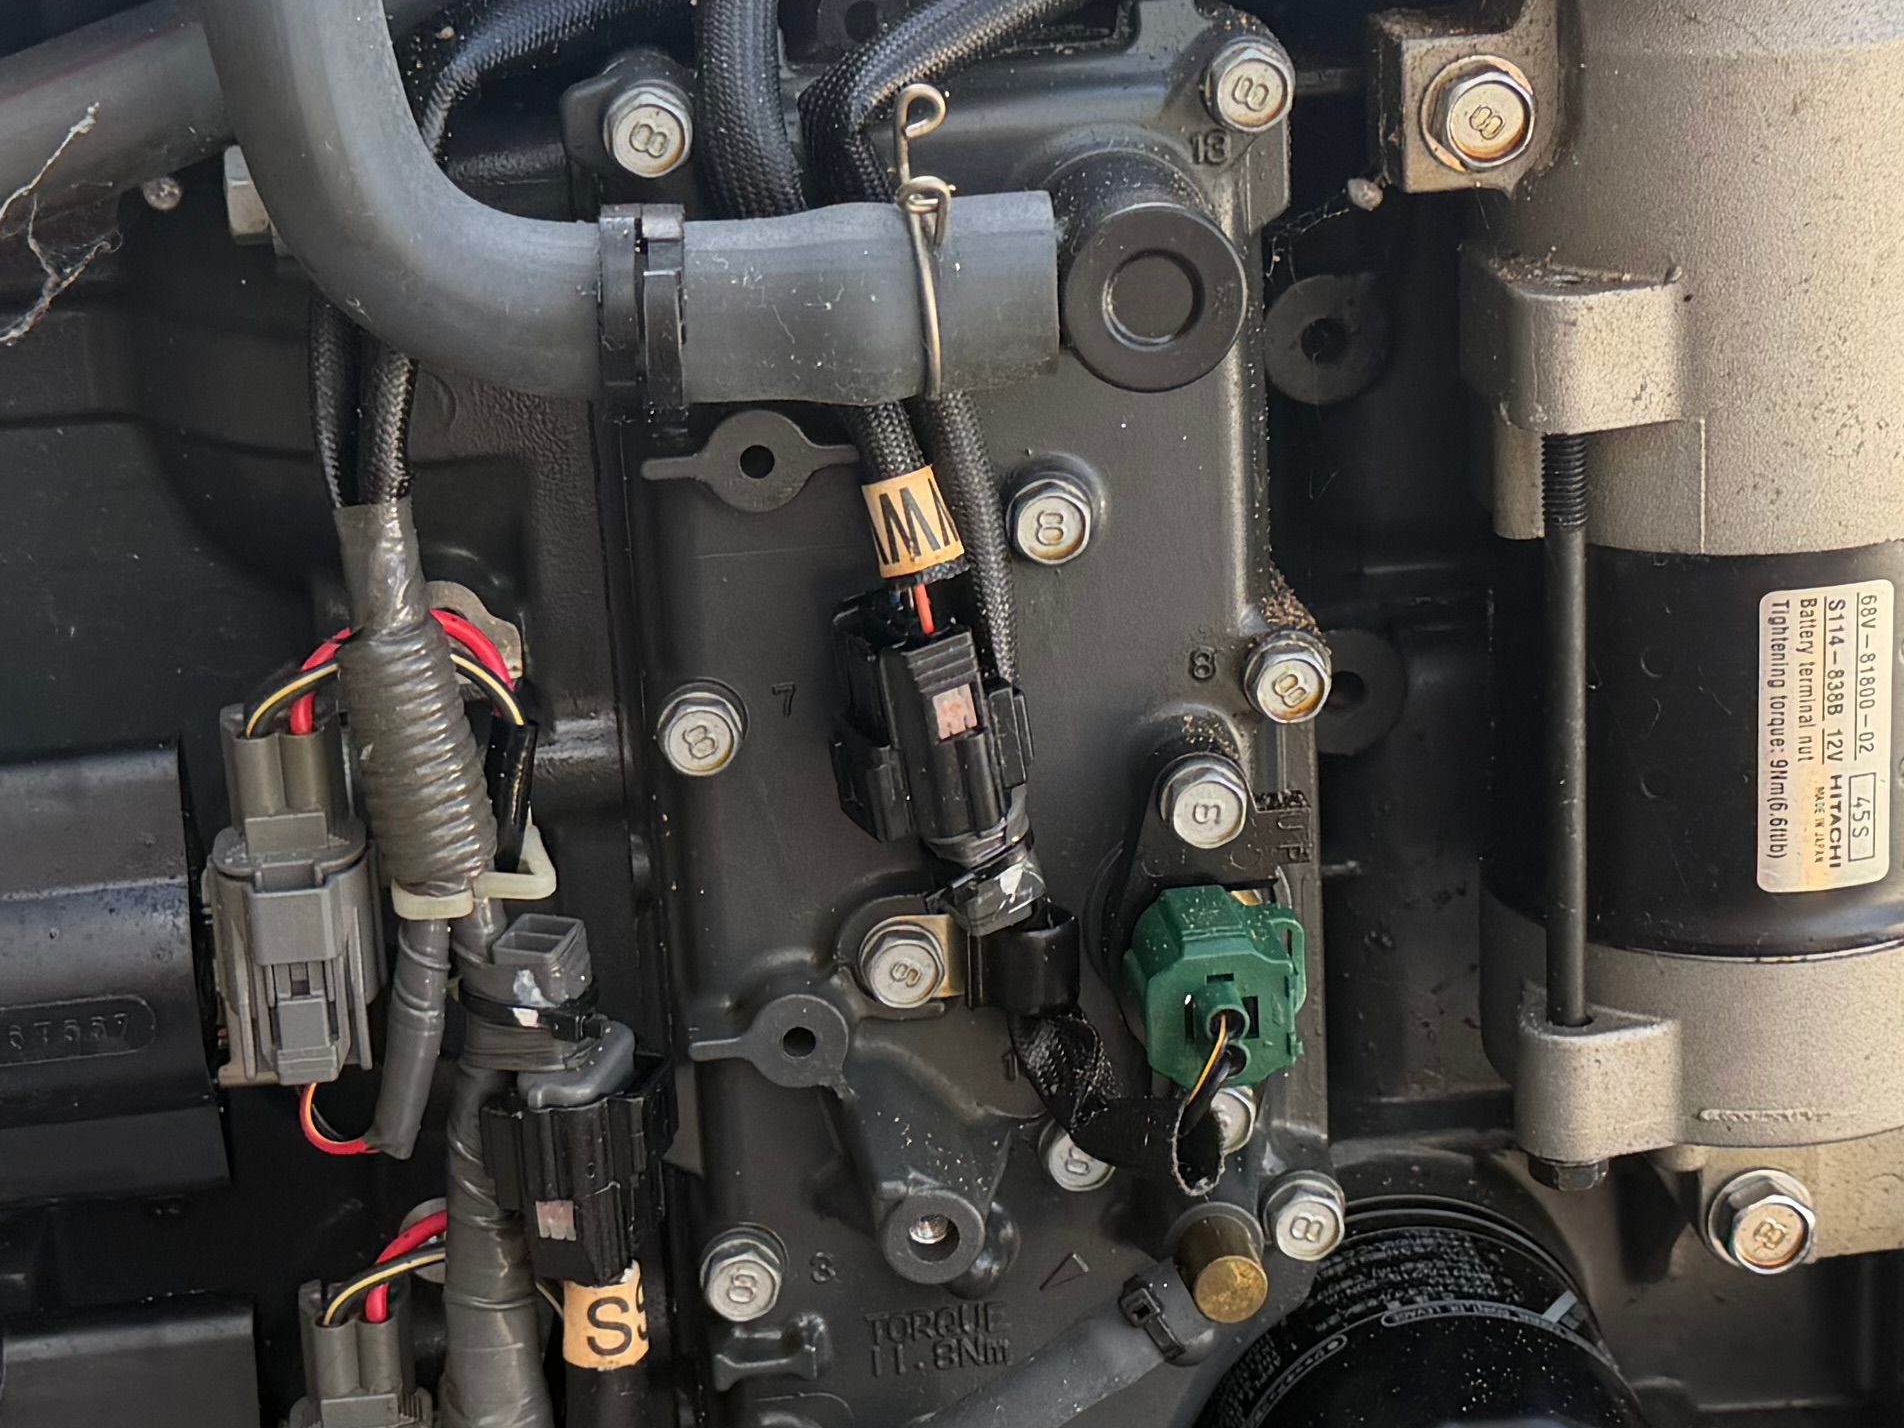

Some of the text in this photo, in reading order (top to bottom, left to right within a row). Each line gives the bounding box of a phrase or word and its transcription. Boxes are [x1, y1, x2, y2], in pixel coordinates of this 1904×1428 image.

[1191, 134, 1227, 164] 13
[1188, 646, 1216, 678] 8
[1766, 599, 1790, 689] Tightening
[772, 684, 795, 716] 7
[1795, 597, 1818, 763] Battery terminal nut
[1826, 598, 1846, 763] S114-838B 12V
[1767, 695, 1788, 754] torque:
[1813, 785, 1826, 815] MADE
[1828, 774, 1843, 869] HITACHI
[1851, 795, 1872, 839] 45S
[864, 1301, 1012, 1346] TORQUE
